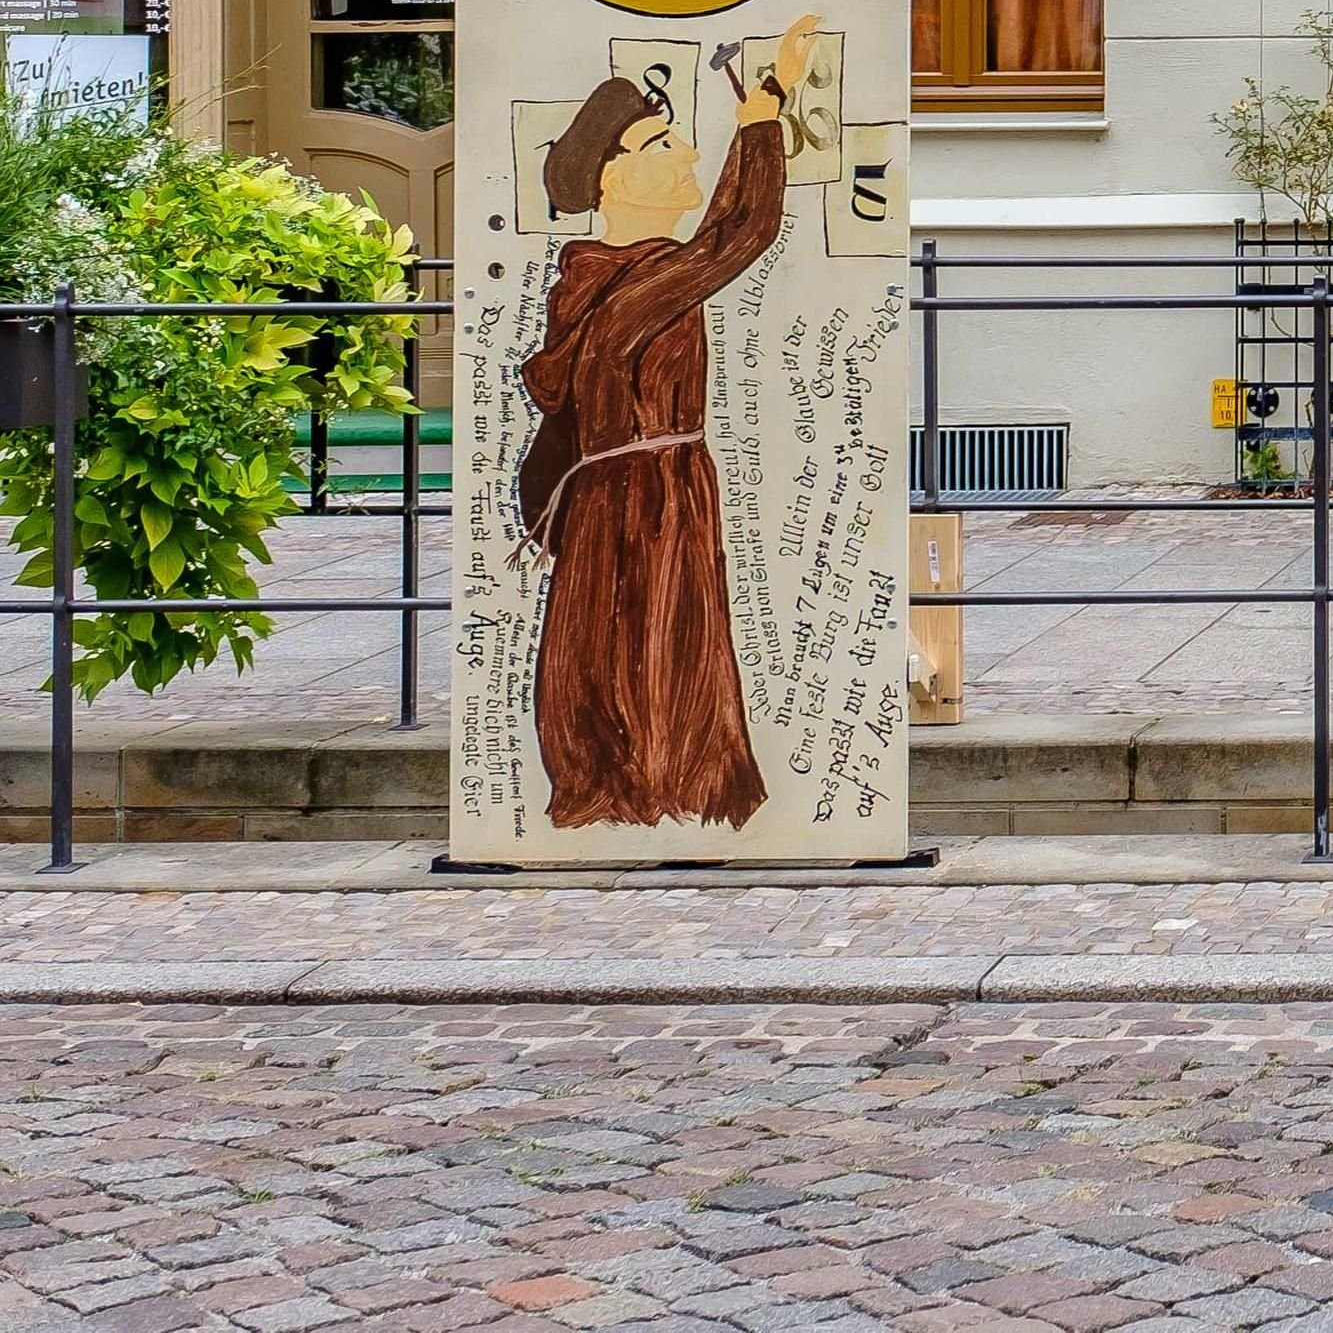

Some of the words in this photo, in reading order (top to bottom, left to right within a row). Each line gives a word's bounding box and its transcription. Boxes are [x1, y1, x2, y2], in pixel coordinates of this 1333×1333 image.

[737, 210, 799, 317] Ablassbrief
[476, 305, 506, 348] Das
[708, 301, 726, 335] auf
[782, 315, 809, 346] der
[736, 328, 765, 368] ohne
[780, 351, 799, 371] ist
[808, 306, 849, 399] Gewissen
[459, 353, 493, 407] passt
[737, 377, 763, 426] auch
[474, 415, 492, 443] wie
[715, 416, 738, 438] hat
[787, 376, 816, 443] Glaube
[471, 451, 493, 474] die
[794, 455, 819, 489] der
[858, 444, 889, 492] Gott
[470, 482, 492, 542] Faust
[740, 492, 759, 521] und
[819, 512, 838, 535] um
[840, 501, 873, 568] unser
[732, 574, 751, 603] der
[752, 586, 772, 616] von
[795, 596, 816, 613] 7
[827, 572, 854, 603] ist
[853, 568, 894, 635] Faust
[456, 610, 497, 675] Auge.
[487, 609, 512, 695] Kuemmere
[784, 619, 817, 682] braucht
[808, 610, 849, 663] Burg
[847, 638, 877, 667] die
[481, 699, 509, 734] dich
[748, 671, 771, 724] Jeder
[772, 687, 796, 728] Man
[798, 672, 830, 721] feste
[842, 678, 868, 715] wie
[864, 679, 903, 748] Auge.
[461, 694, 483, 768] ungelegte
[788, 728, 816, 775] Eine
[827, 718, 859, 782] passt
[482, 739, 511, 777] nicht
[461, 775, 484, 818] Eier
[490, 782, 505, 805] um
[812, 778, 841, 824] Das
